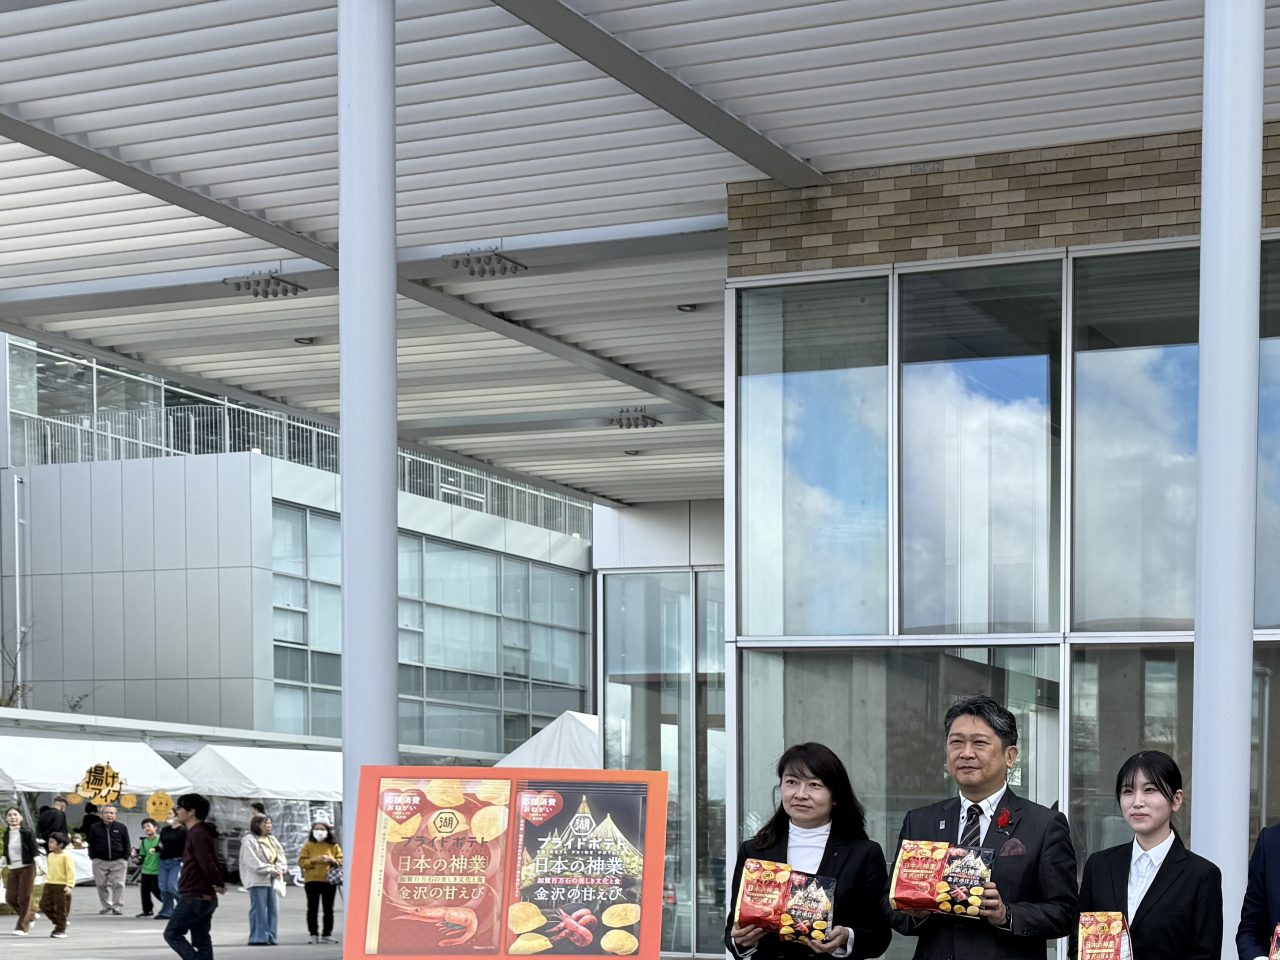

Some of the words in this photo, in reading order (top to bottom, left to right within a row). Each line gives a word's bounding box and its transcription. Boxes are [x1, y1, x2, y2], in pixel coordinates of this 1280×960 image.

[85, 766, 119, 789] 揚げ
[401, 836, 489, 848] プライドポテト
[537, 837, 626, 850] プライドポテト
[398, 855, 487, 873] 日本の神業
[535, 857, 624, 875] 日本の神業
[398, 886, 486, 900] 金沢の甘えび
[534, 886, 623, 901] 金沢の甘えび
